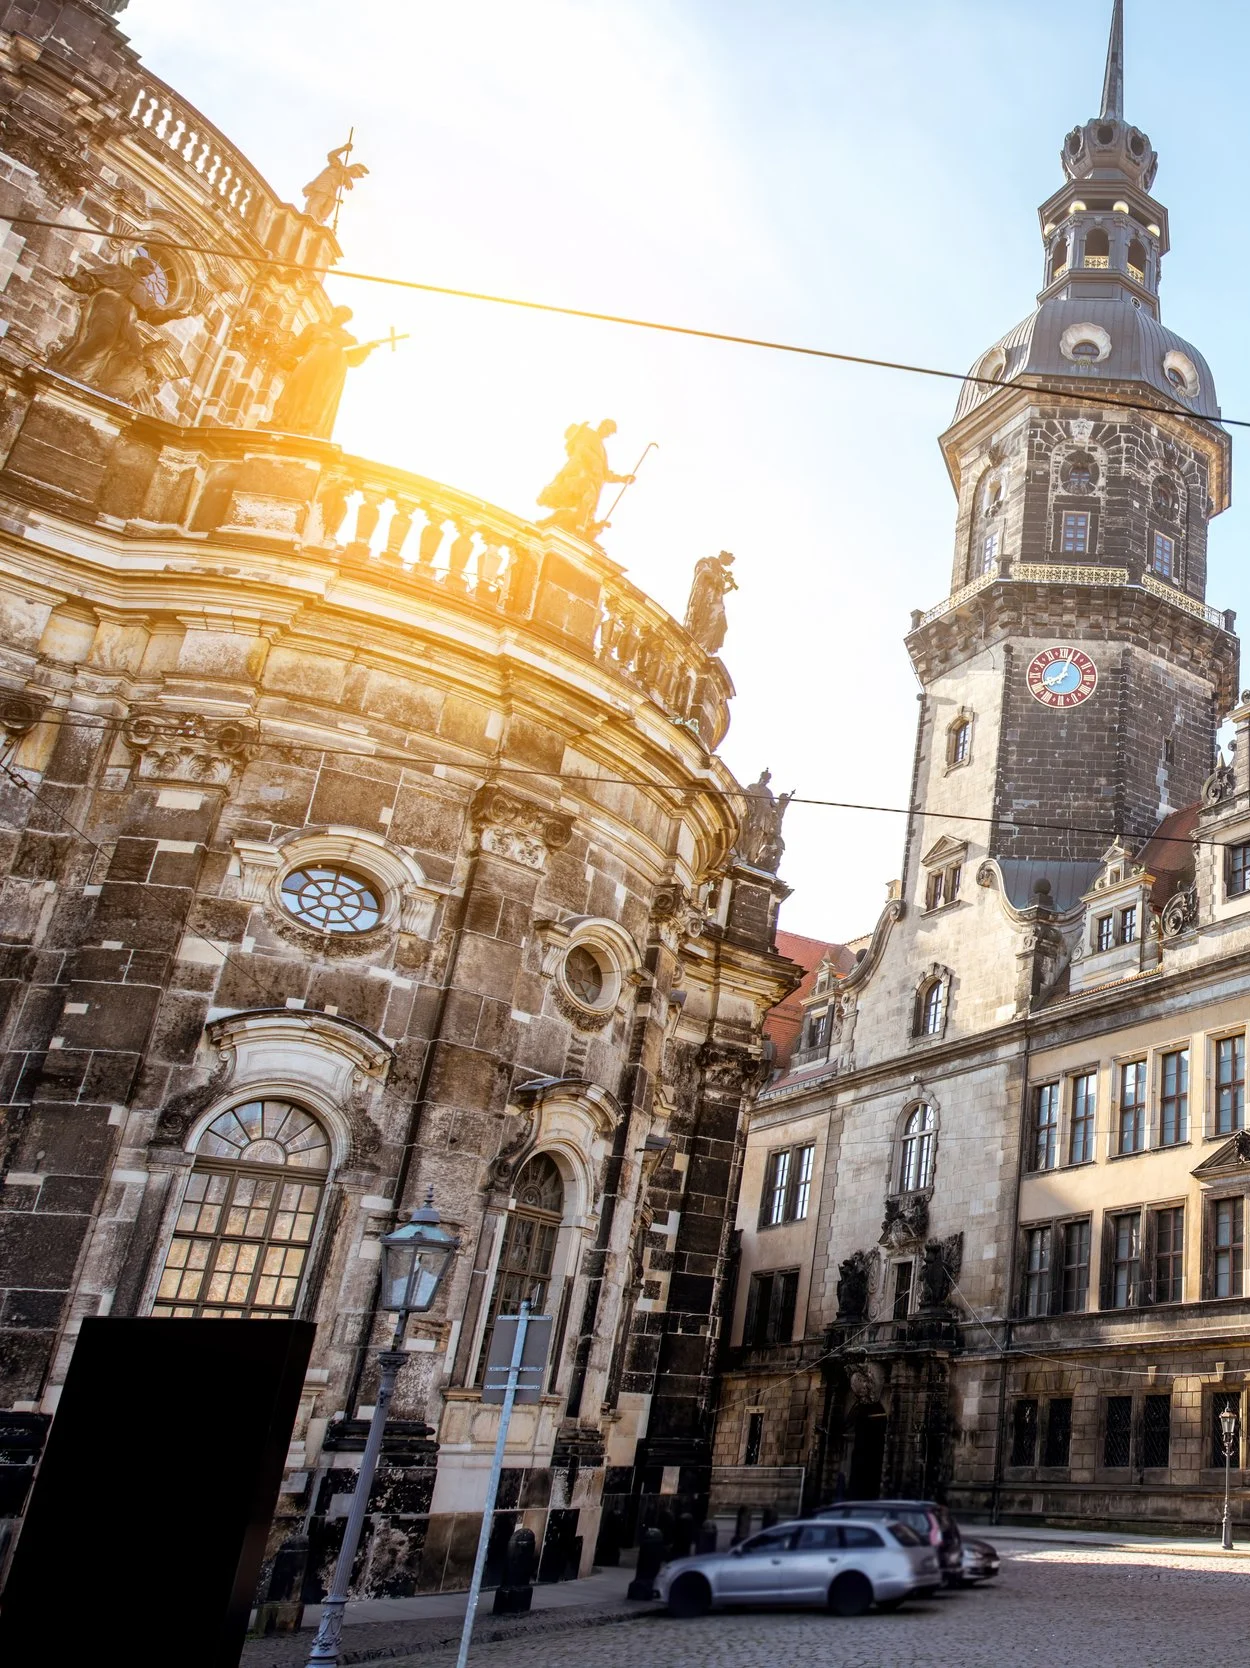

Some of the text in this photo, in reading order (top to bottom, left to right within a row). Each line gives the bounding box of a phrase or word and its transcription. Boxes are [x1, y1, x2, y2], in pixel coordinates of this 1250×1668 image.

[1045, 650, 1055, 661] XI
[1059, 648, 1068, 658] XII
[1073, 652, 1080, 661] I
[1034, 660, 1045, 668] X
